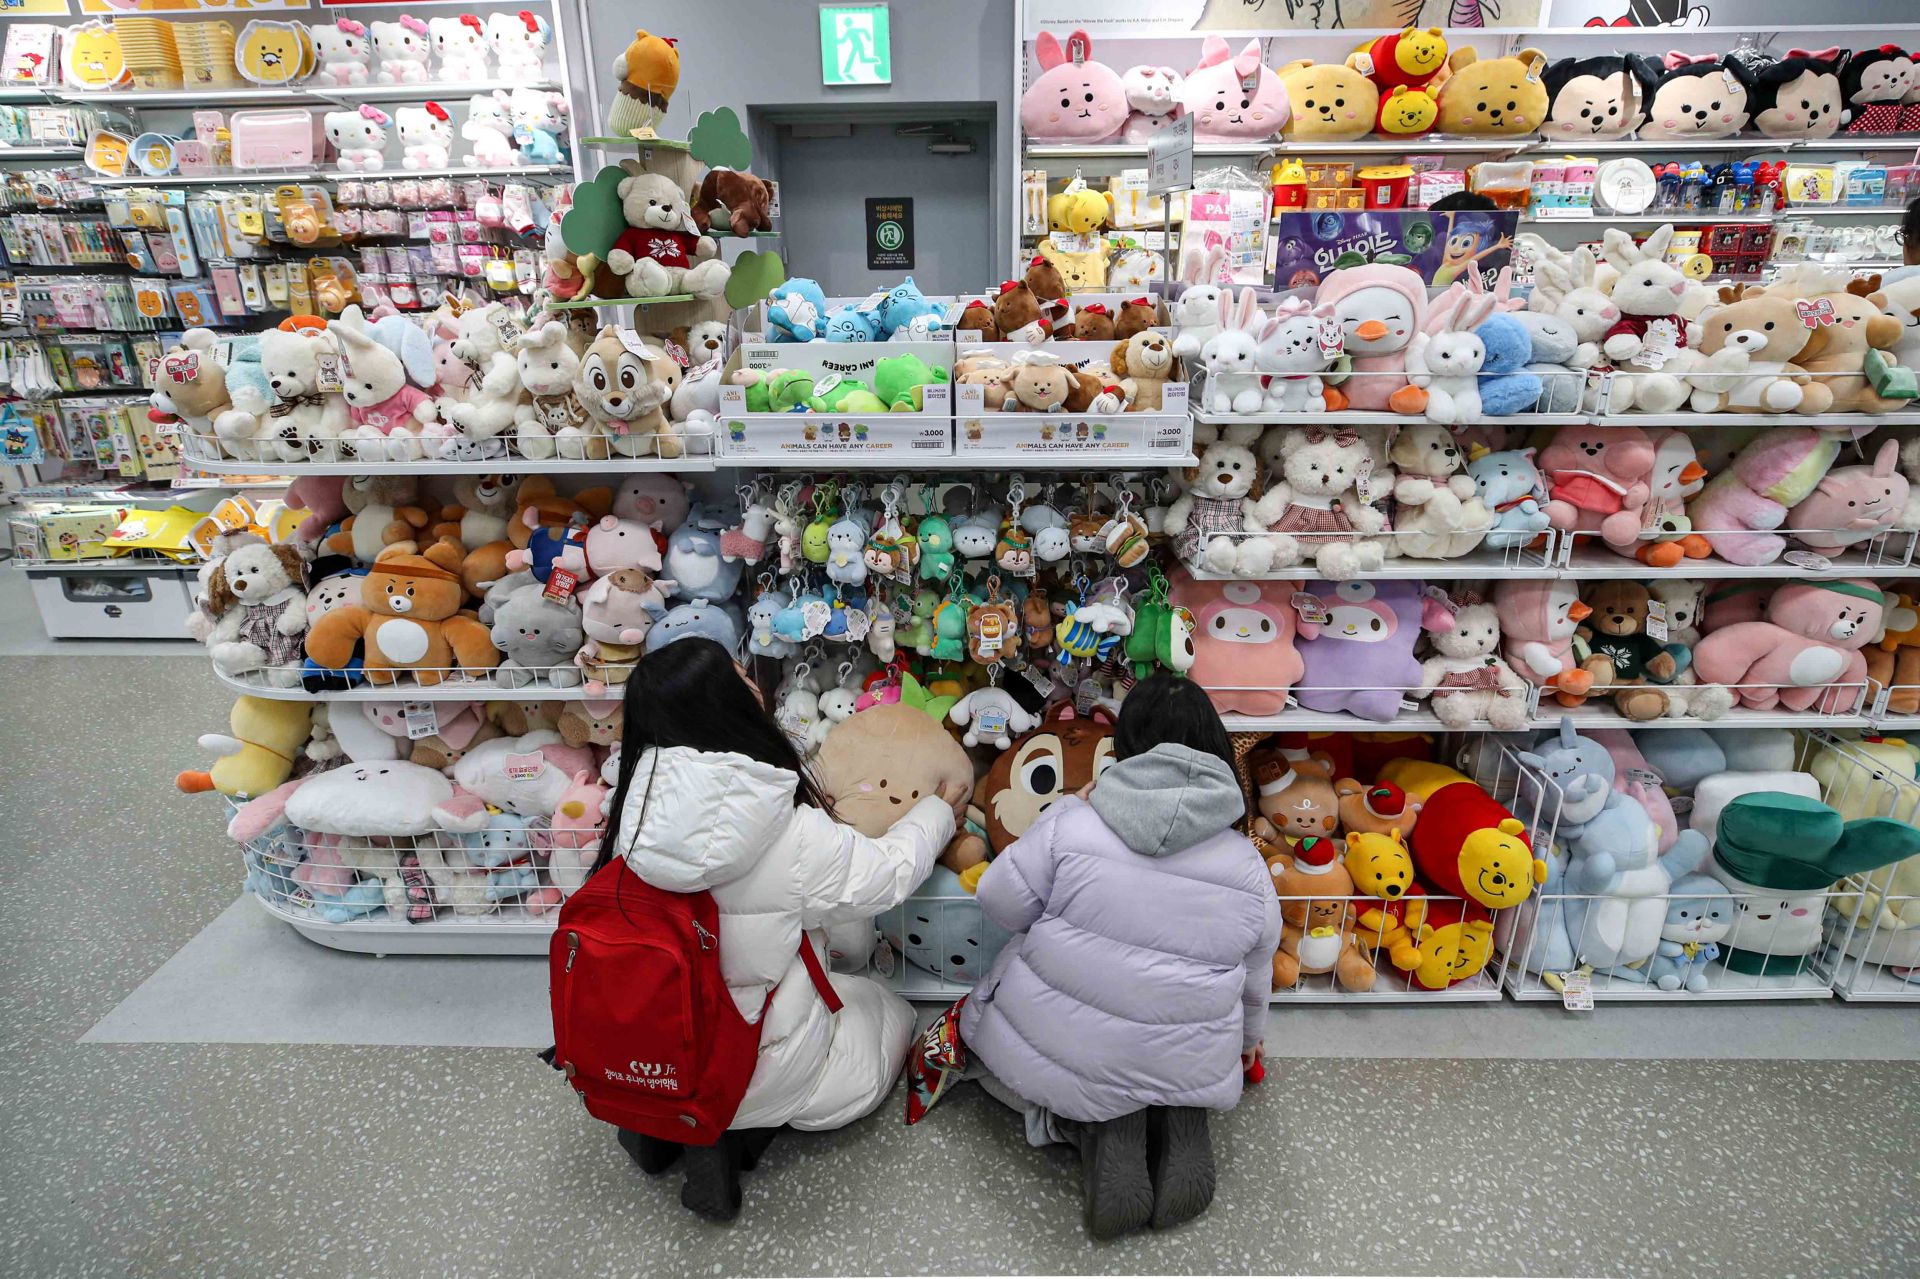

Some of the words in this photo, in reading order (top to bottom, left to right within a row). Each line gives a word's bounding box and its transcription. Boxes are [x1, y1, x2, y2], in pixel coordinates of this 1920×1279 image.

[1352, 232, 1369, 240] PIXAR
[1487, 268, 1498, 286] 2
[859, 359, 875, 371] ANI
[629, 1060, 662, 1076] CYJ
[664, 1063, 677, 1076] Jr.
[626, 1074, 647, 1087] 주니어
[647, 1078, 678, 1091] 영어학원
